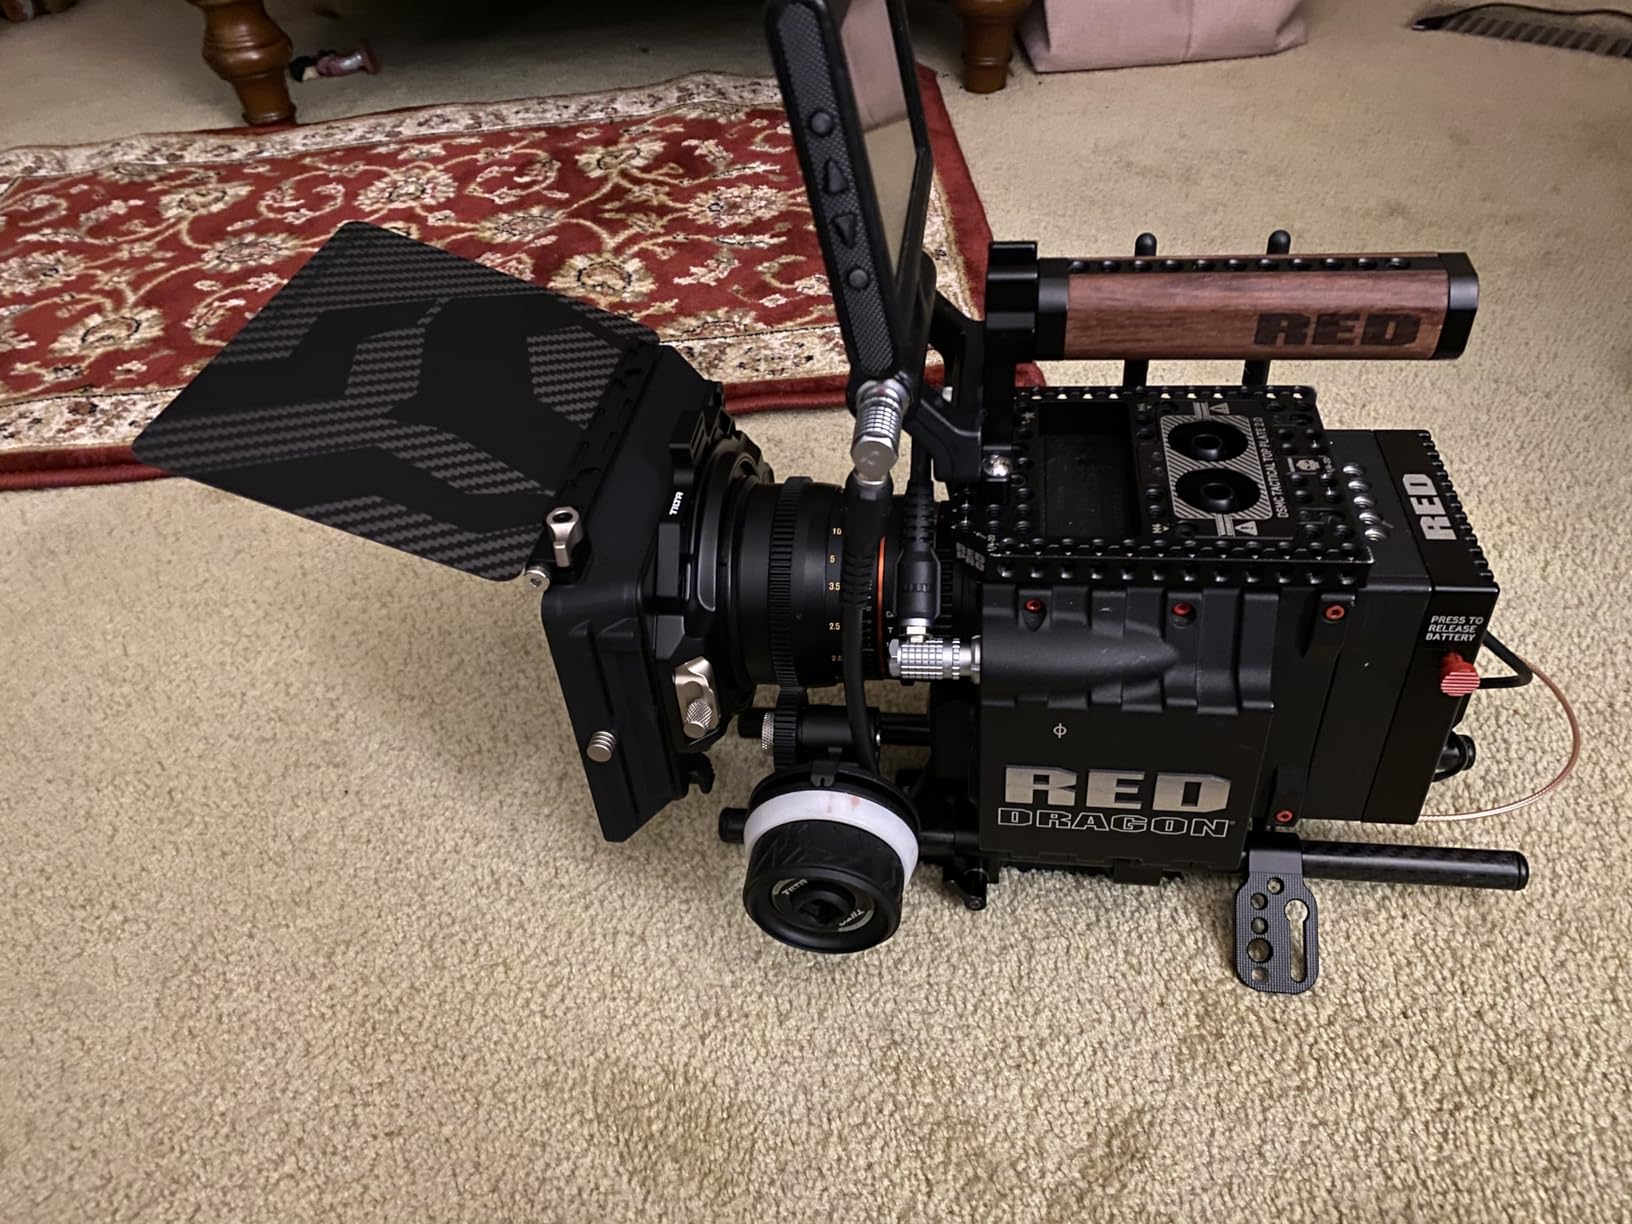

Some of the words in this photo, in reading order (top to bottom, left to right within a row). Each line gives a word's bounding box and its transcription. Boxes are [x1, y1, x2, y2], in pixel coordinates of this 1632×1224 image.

[1253, 312, 1422, 347] RED
[1255, 427, 1272, 449] PLATE
[1260, 449, 1275, 463] TOP
[1264, 462, 1283, 497] TACTICAL
[669, 491, 684, 515] TILTA
[1402, 473, 1457, 540] RED
[832, 527, 842, 536] 10
[829, 555, 836, 563] 5
[828, 582, 841, 591] 3.5
[828, 622, 841, 631] 2.5
[1430, 615, 1467, 625] PRESS
[1468, 615, 1484, 625] TO
[1428, 624, 1478, 633] RELEASE
[1425, 632, 1477, 642] BATTERY
[1005, 764, 1232, 813] RED
[998, 807, 1230, 838] DRAGON
